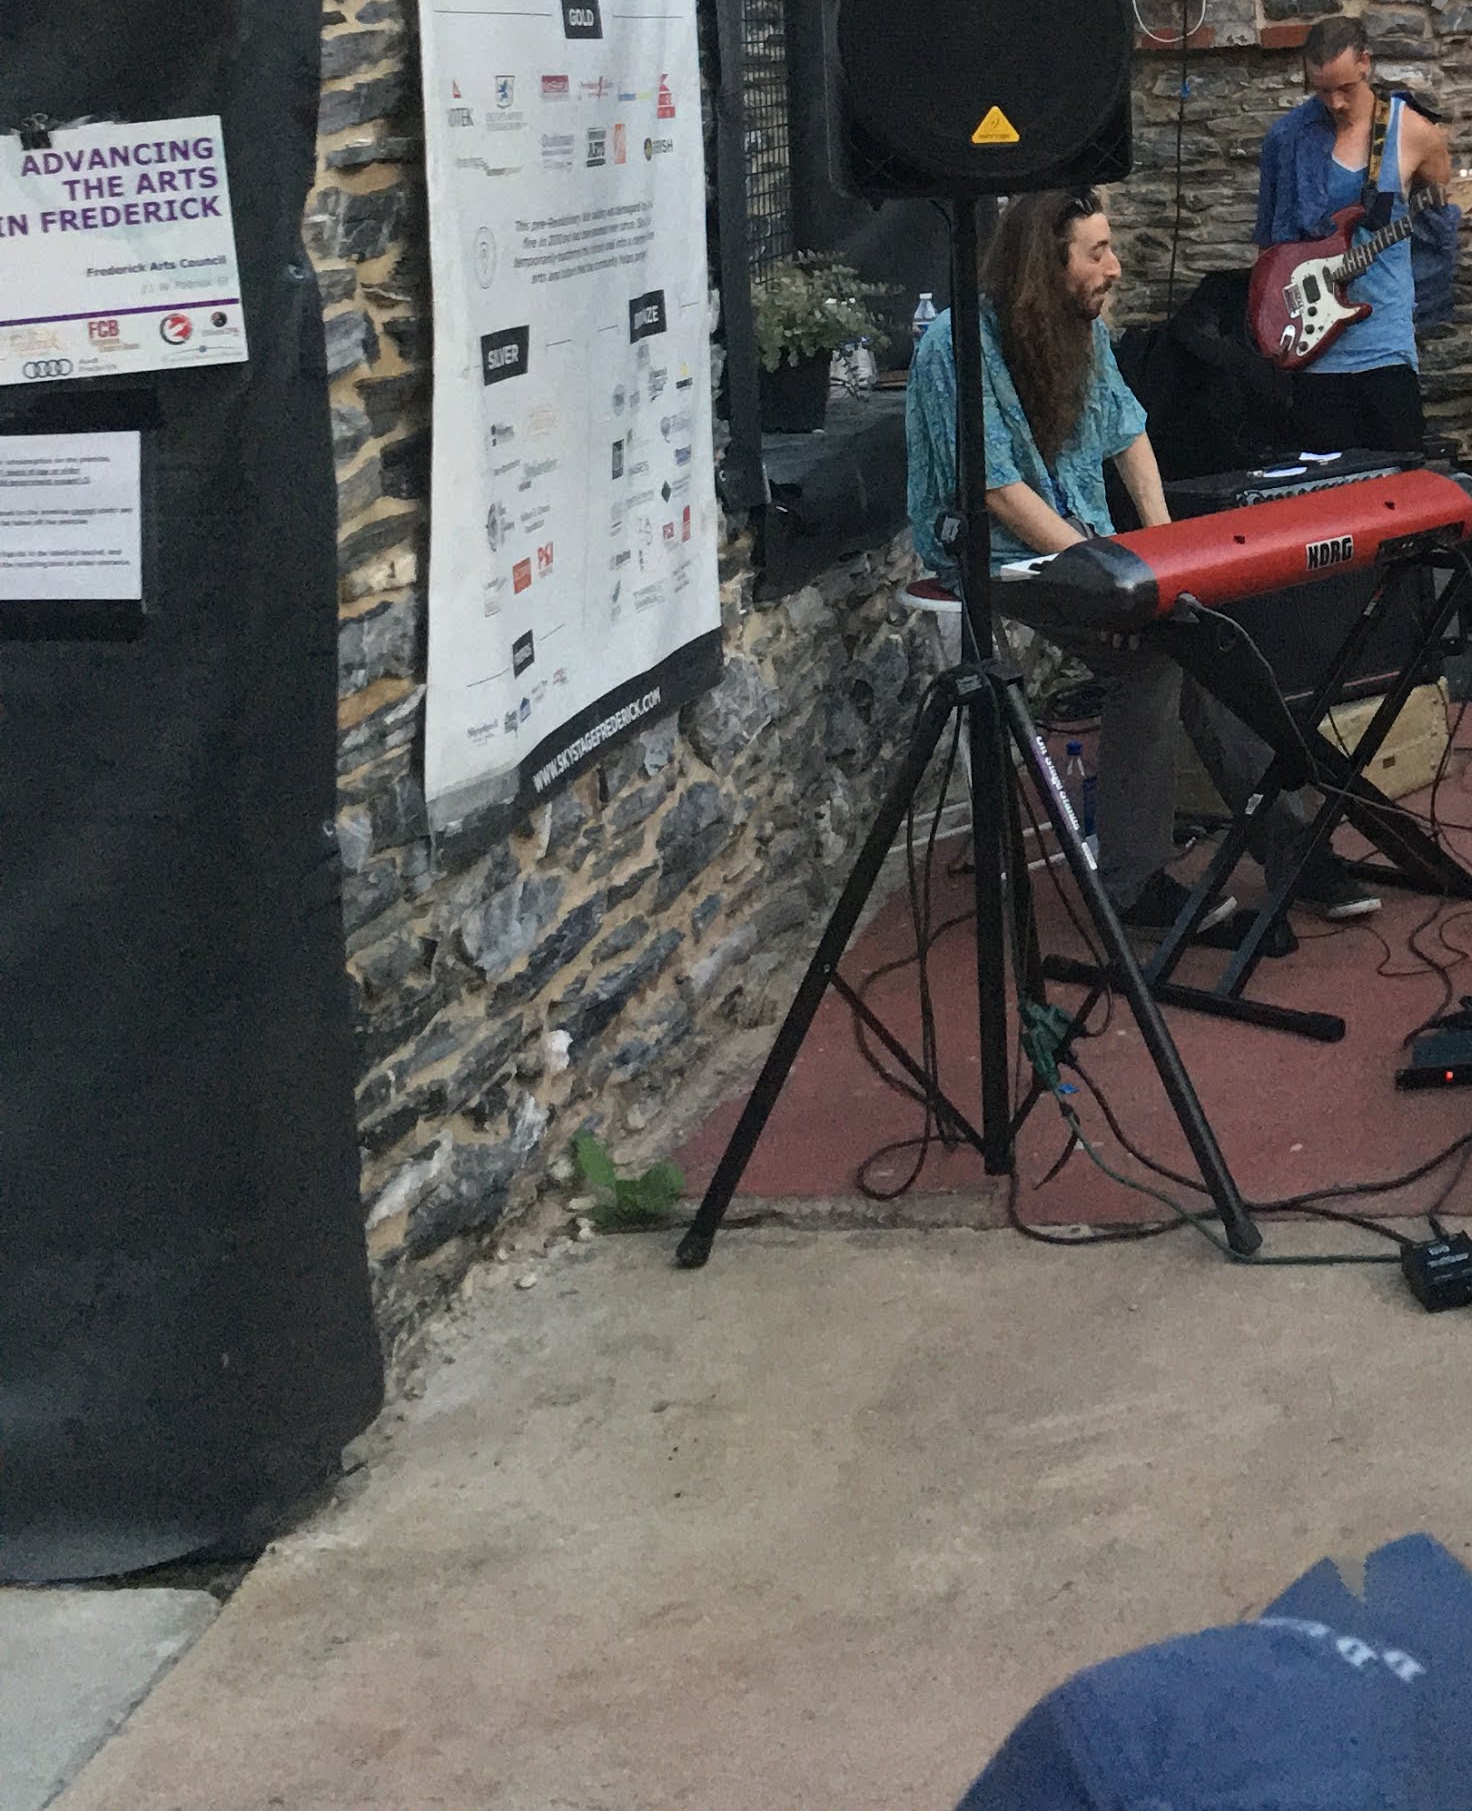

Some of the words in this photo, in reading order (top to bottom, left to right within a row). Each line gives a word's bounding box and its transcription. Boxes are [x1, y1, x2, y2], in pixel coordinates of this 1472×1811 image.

[568, 8, 595, 27] GOLD
[21, 137, 214, 177] ADVANCING
[62, 175, 124, 201] THE
[136, 166, 218, 195] ARTS
[40, 195, 222, 233] FREDERICK
[87, 262, 146, 277] Frederick
[150, 261, 176, 271] Arts
[180, 255, 227, 268] Council
[88, 319, 120, 339] FCB
[1307, 537, 1352, 570] KORG
